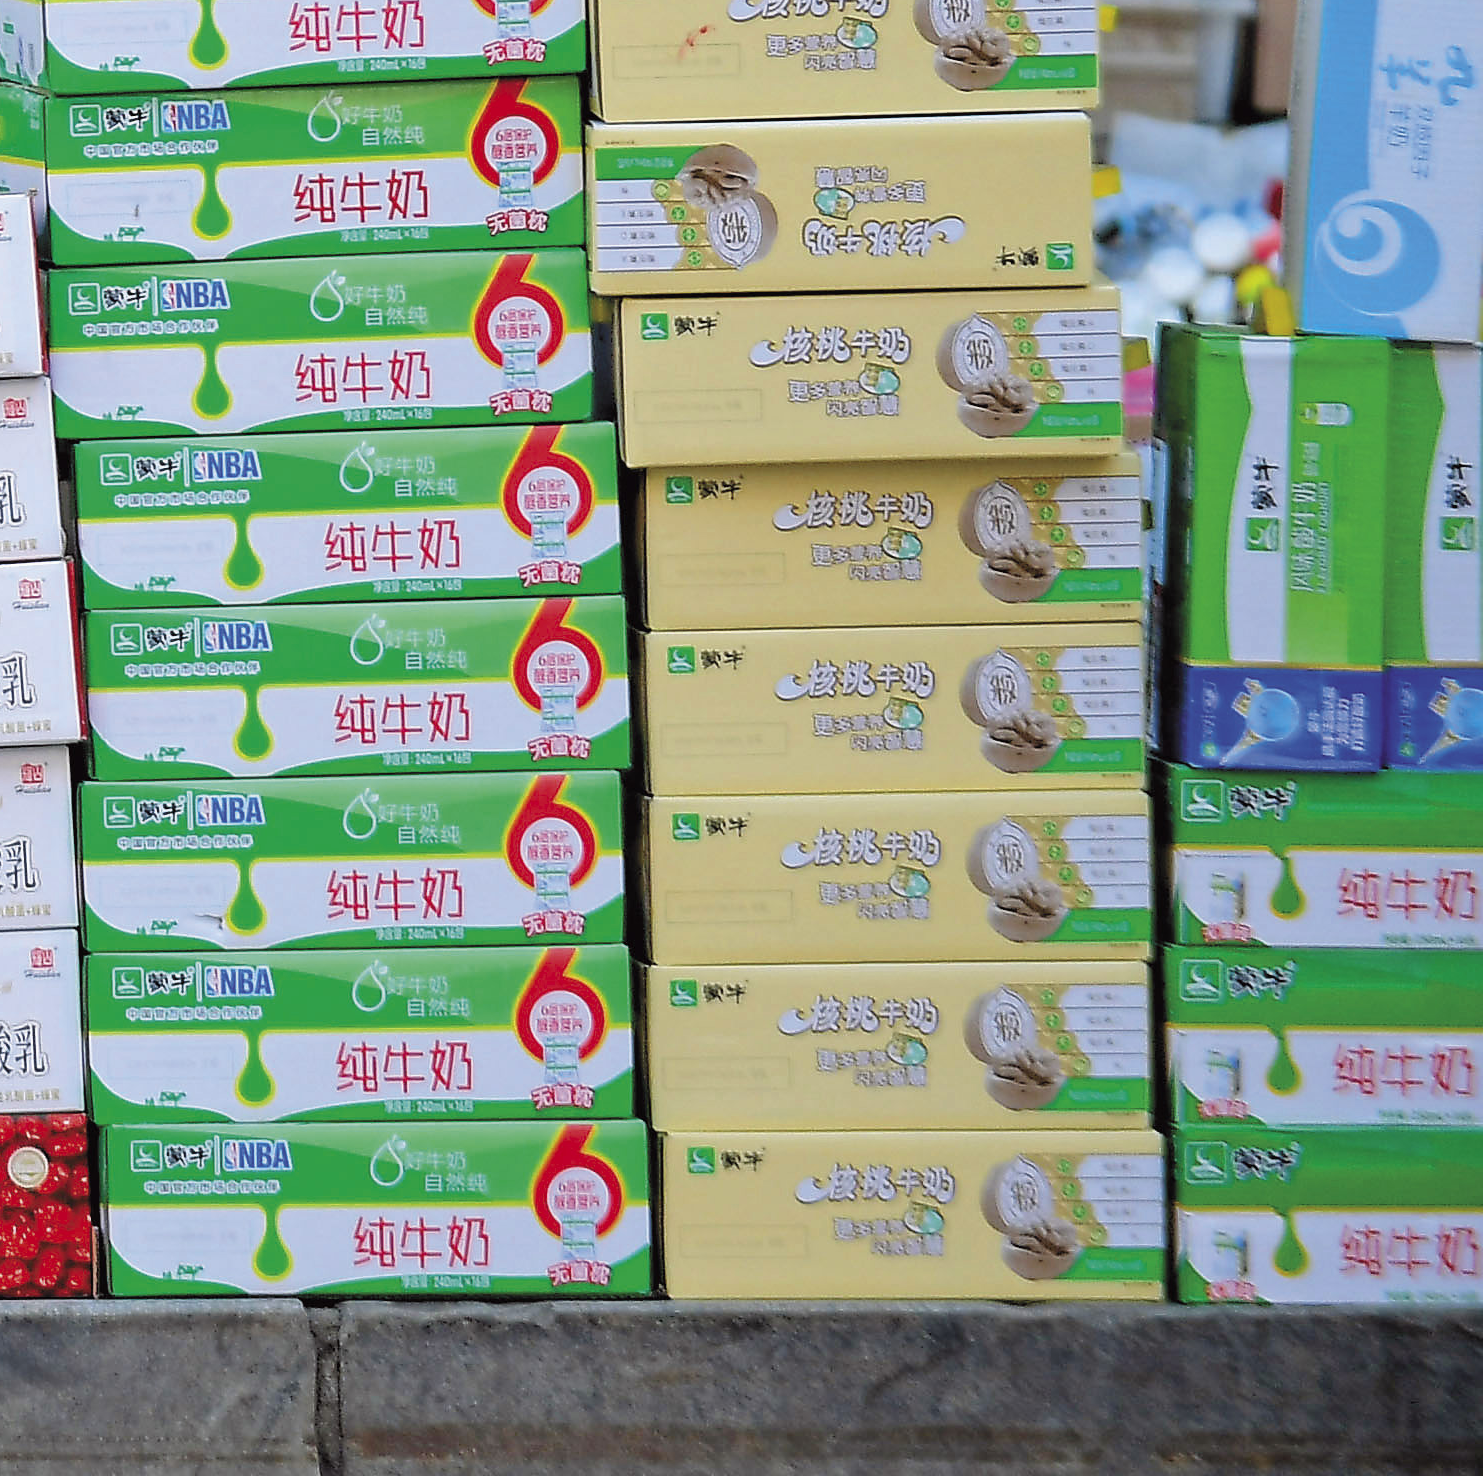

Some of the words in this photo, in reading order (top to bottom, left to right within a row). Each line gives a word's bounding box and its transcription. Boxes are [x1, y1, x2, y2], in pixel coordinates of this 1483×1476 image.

[291, 169, 430, 225] 纯牛奶
[803, 215, 962, 258] 核桃牛奶
[103, 282, 151, 311] 蒙牛
[177, 279, 231, 310] NBA
[344, 284, 406, 305] 好牛奶
[365, 306, 428, 326] 自然纯
[751, 325, 910, 368] 核桃牛奶
[293, 349, 432, 405] 纯牛奶
[208, 450, 262, 481] NBA
[774, 490, 933, 533] 核桃牛奶
[323, 518, 462, 574] 纯牛奶
[146, 622, 194, 651] 蒙牛
[219, 621, 273, 652] NBA
[775, 659, 934, 702] 核桃牛奶
[333, 691, 472, 747] 纯牛奶
[1229, 783, 1297, 818] 蒙牛
[326, 867, 465, 923] 纯牛奶
[1337, 868, 1478, 921] 纯牛奶
[147, 966, 195, 995] 蒙牛
[221, 966, 275, 997] NBA
[335, 1039, 474, 1095] 纯牛奶
[1333, 1044, 1474, 1097] 纯牛奶
[352, 1214, 491, 1270] 纯牛奶
[1339, 1225, 1480, 1278] 纯牛奶
